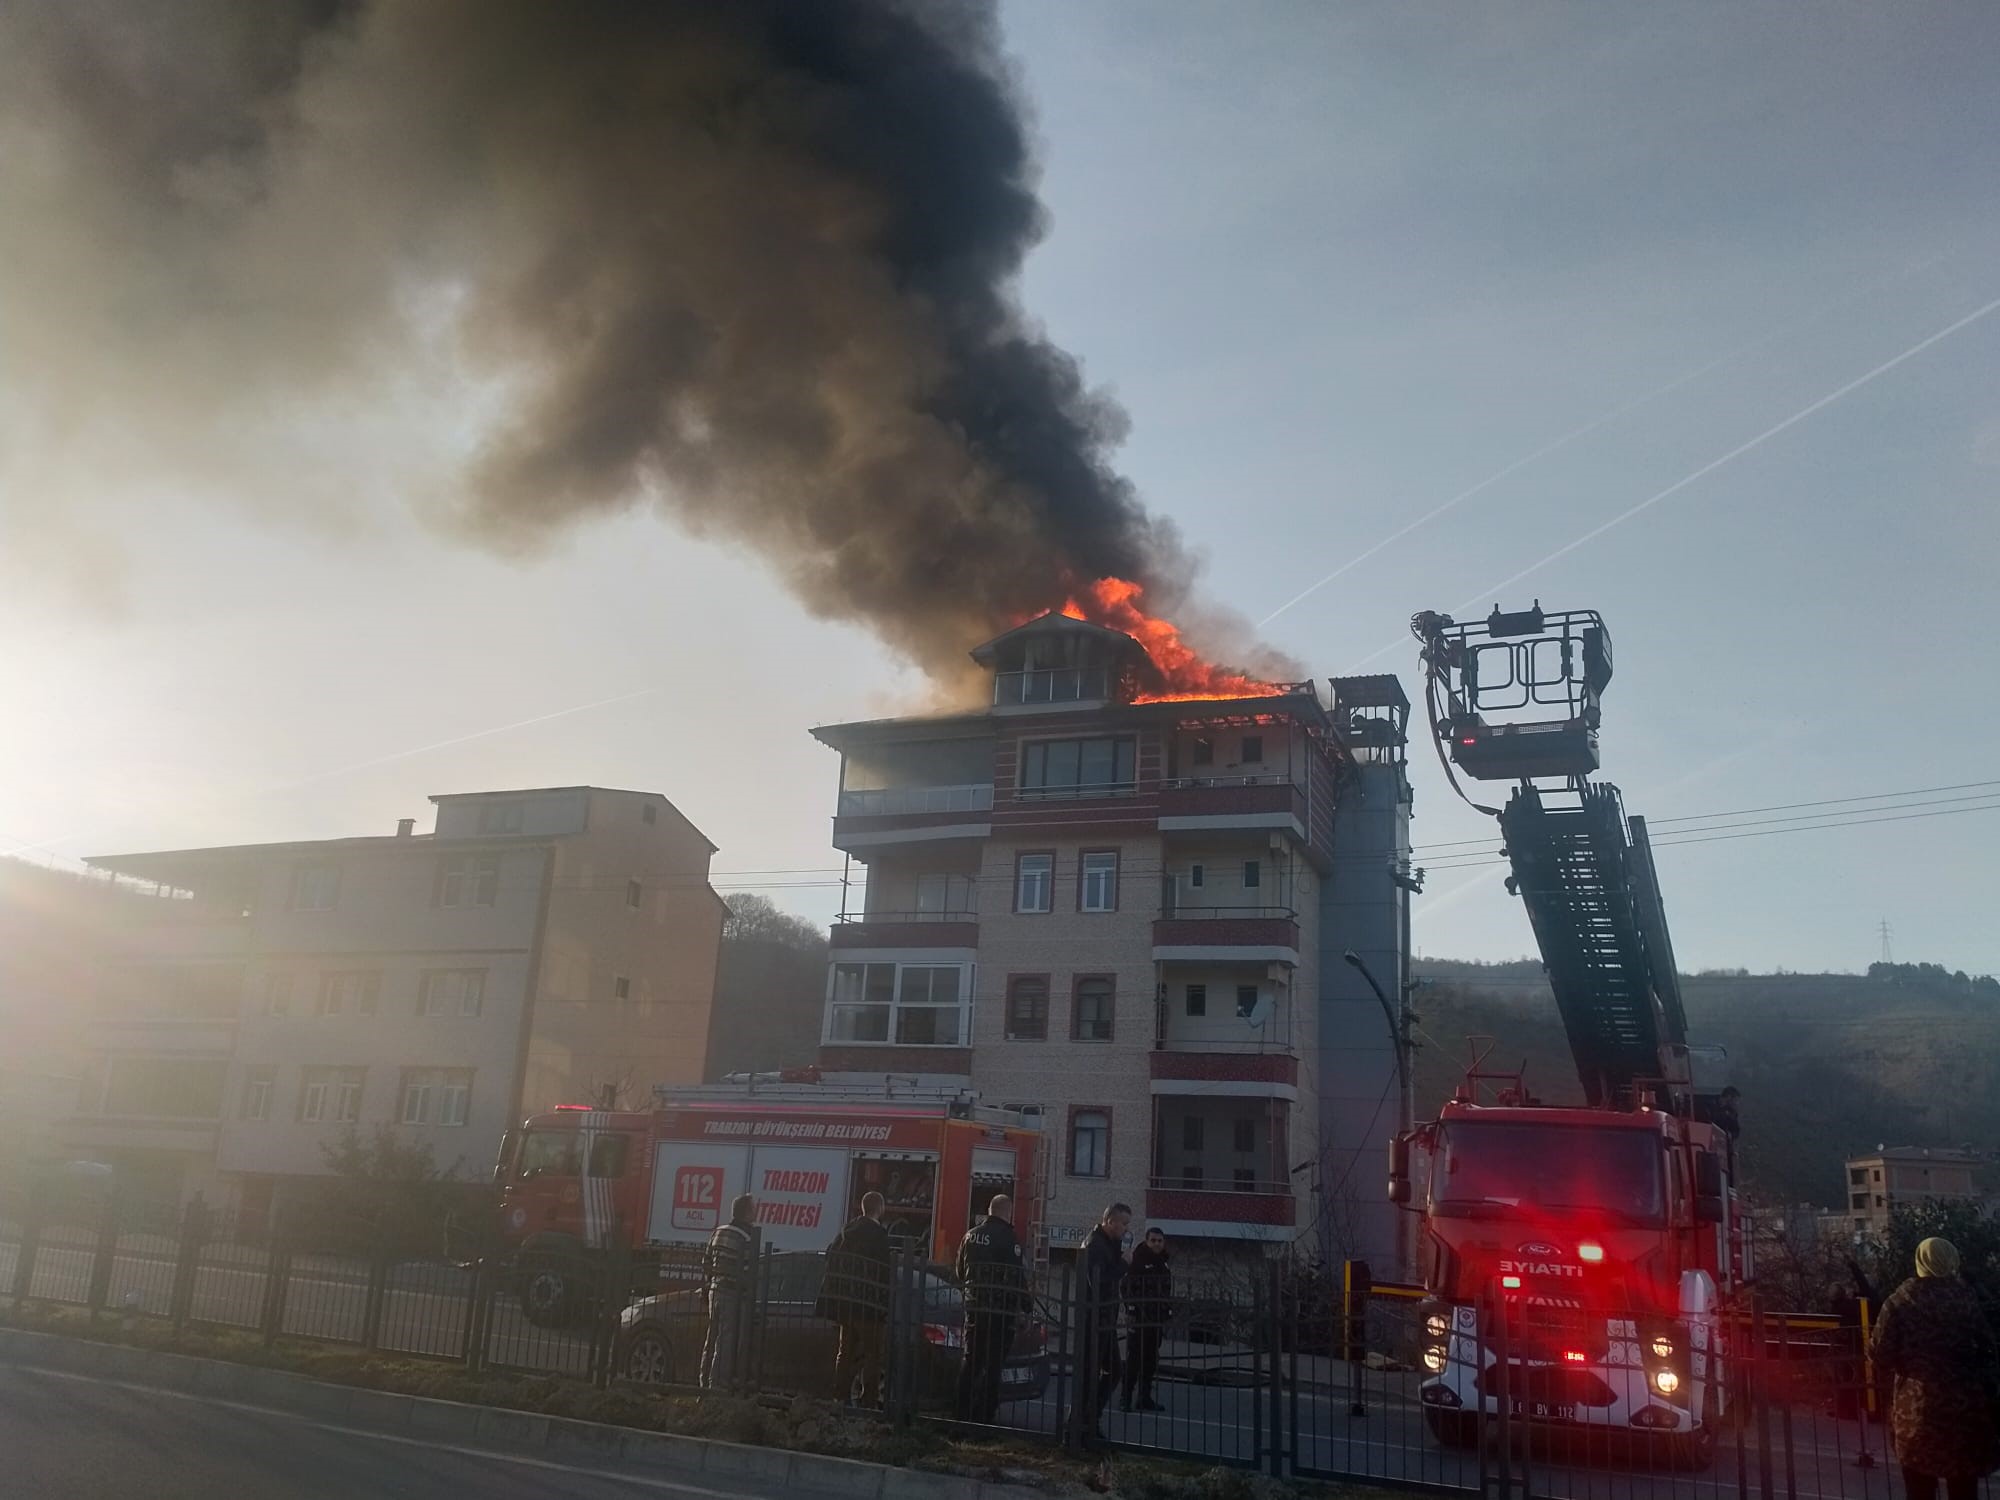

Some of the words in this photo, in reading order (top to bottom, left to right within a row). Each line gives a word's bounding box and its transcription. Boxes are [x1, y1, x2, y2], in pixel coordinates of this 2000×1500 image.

[704, 1121, 751, 1135] TRABZON
[753, 1120, 825, 1138] BÜYÜKŞEHİR
[681, 1173, 715, 1203] 112
[763, 1169, 830, 1194] TRABZON
[755, 1198, 823, 1228] İTFAİYESİ
[1558, 1406, 1574, 1418] 112
